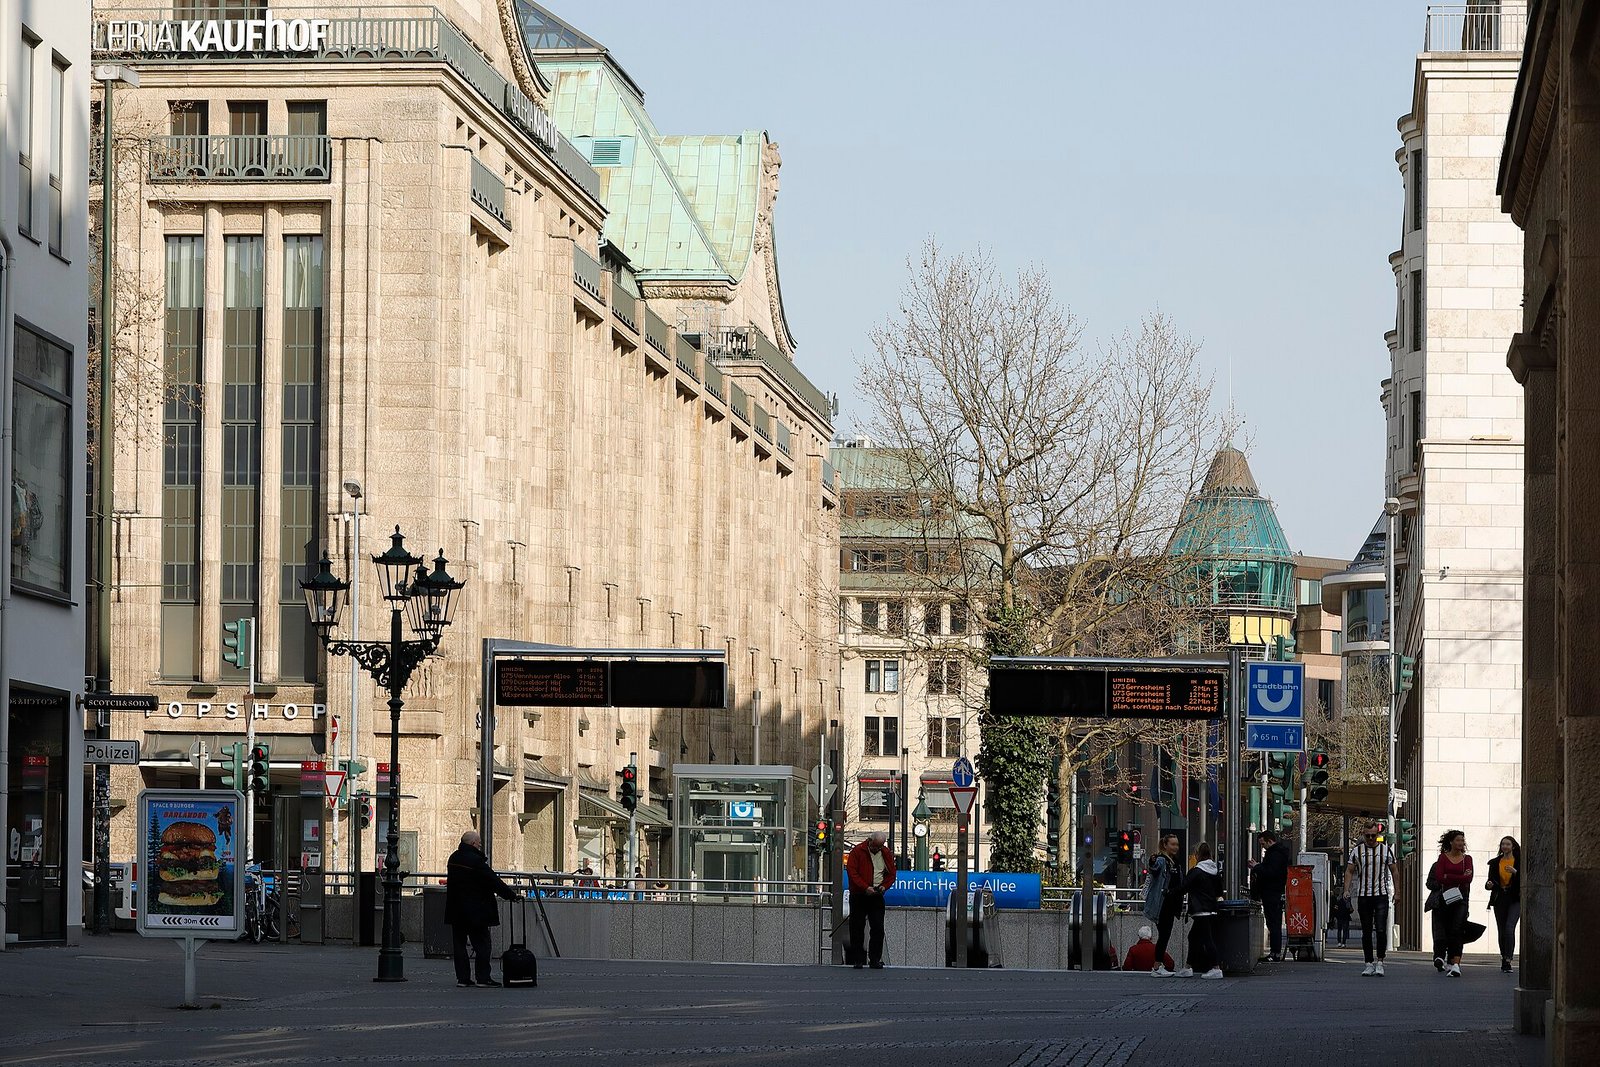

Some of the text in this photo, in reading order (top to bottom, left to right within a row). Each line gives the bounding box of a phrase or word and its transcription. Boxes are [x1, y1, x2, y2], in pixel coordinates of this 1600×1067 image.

[146, 701, 326, 719] OPSHOP
[1260, 733, 1270, 741] 65
[86, 745, 134, 759] Polizei
